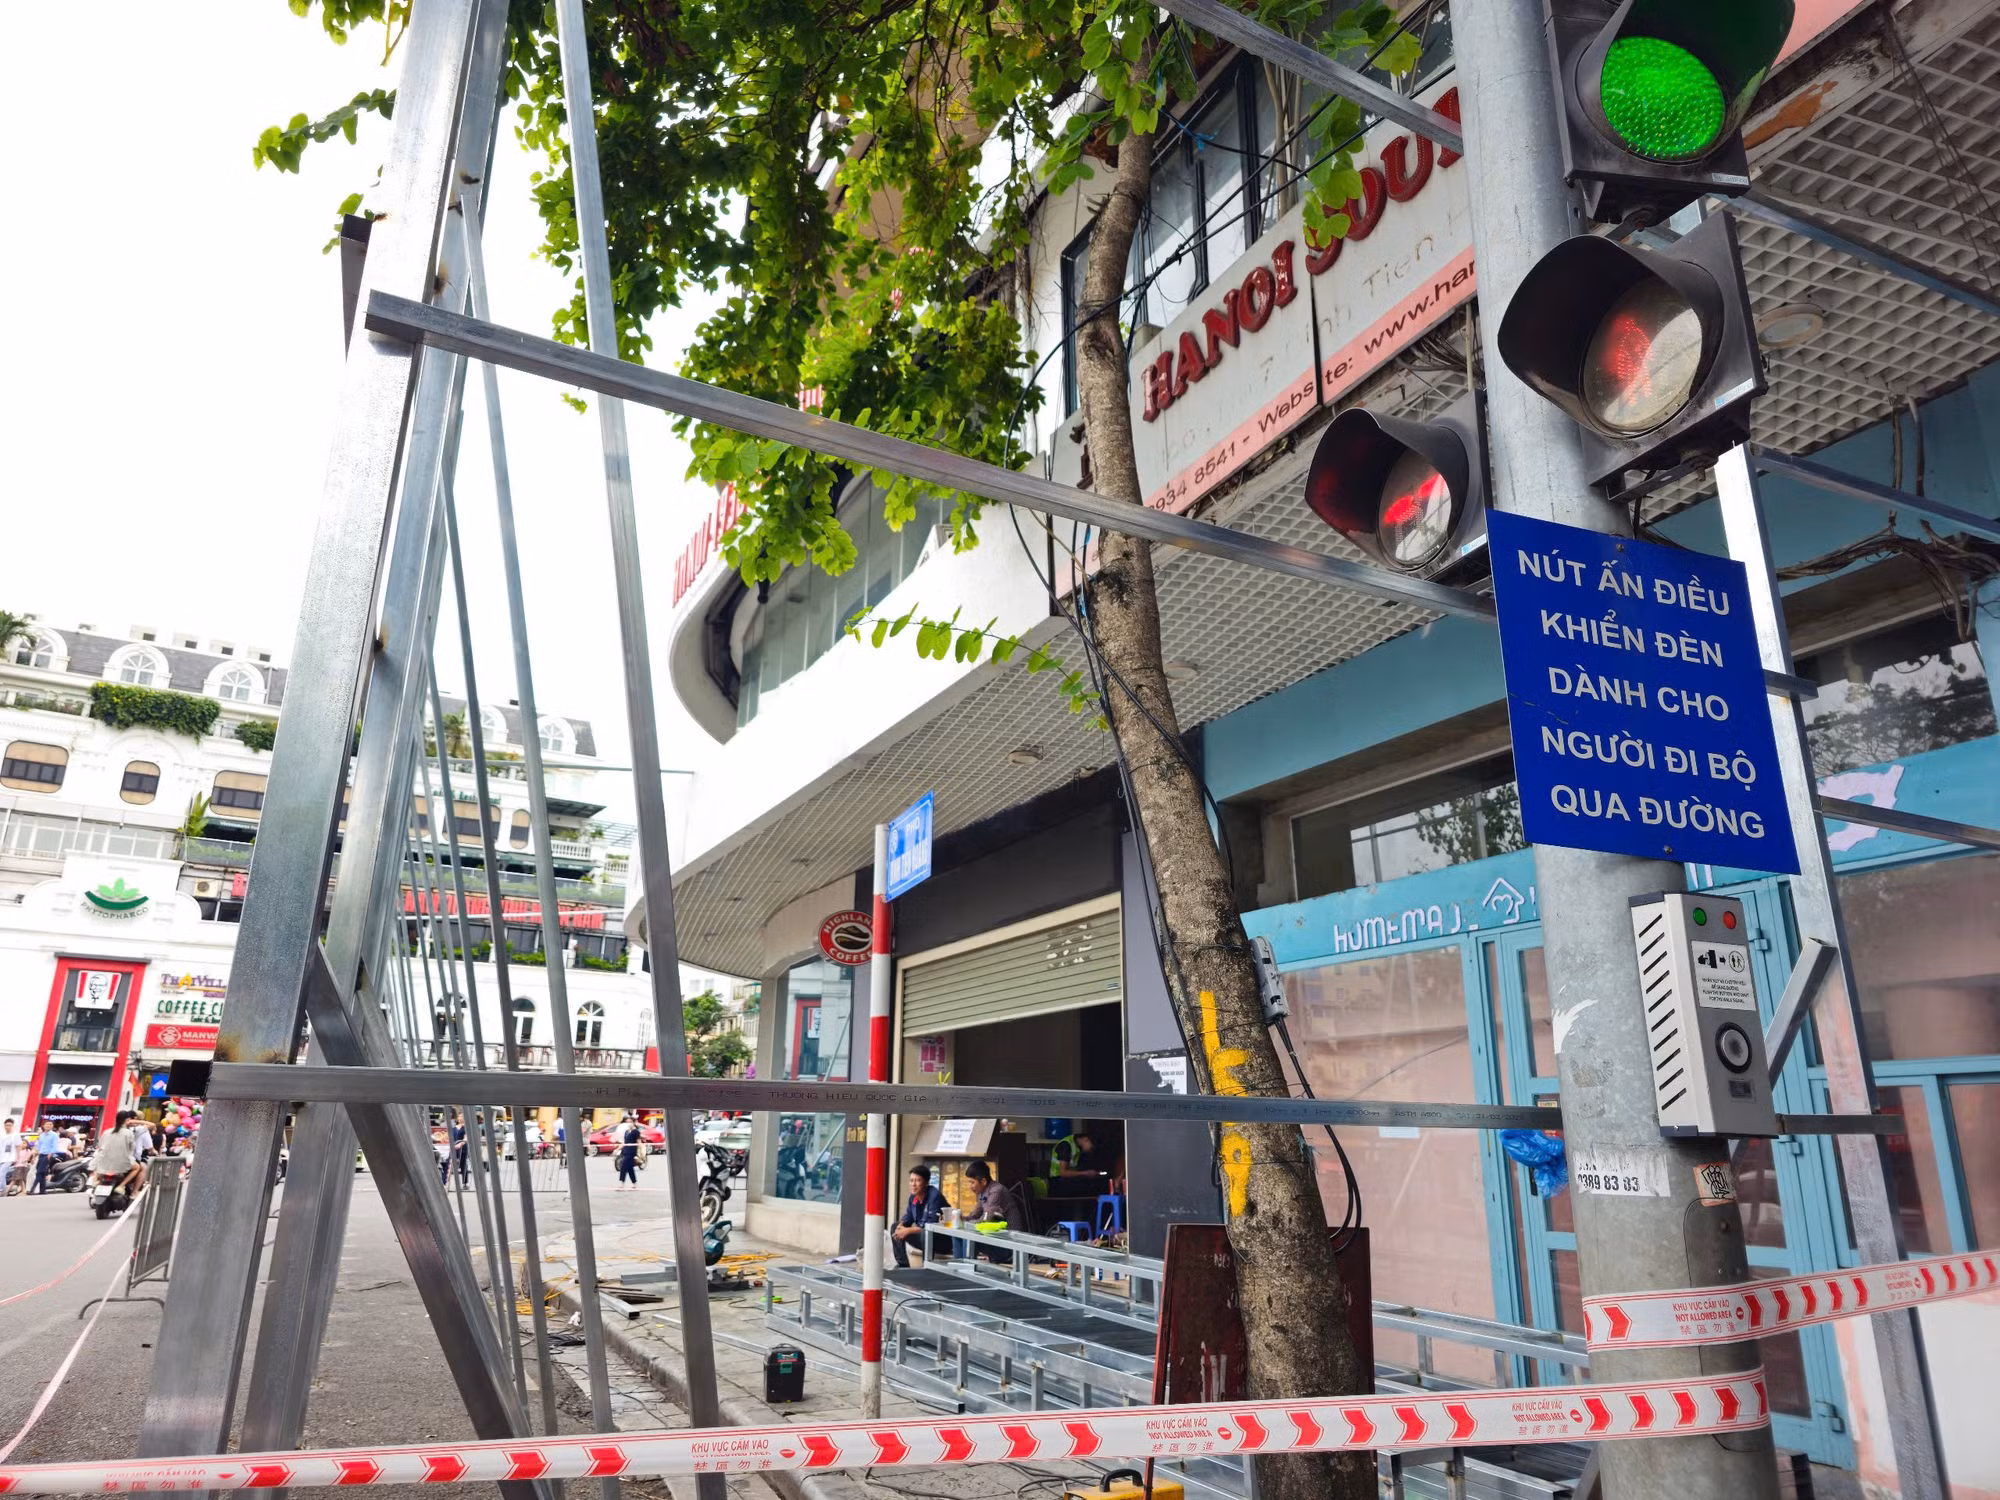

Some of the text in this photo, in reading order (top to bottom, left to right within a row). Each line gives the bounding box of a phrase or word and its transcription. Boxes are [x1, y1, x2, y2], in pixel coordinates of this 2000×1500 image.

[1141, 240, 1298, 423] HANOI
[1194, 441, 1235, 485] 8541
[1517, 549, 1731, 617] NÚT ẤN ĐIỀU
[1540, 608, 1725, 669] KHIỂN ĐÈN
[1548, 663, 1730, 722] DÀNH CHO
[1541, 725, 1758, 792] NGƯỜI ĐI BỘ
[1551, 784, 1766, 840] QUA ĐƯỜNG
[157, 1000, 206, 1015] COFFEE
[46, 1083, 103, 1100] KFC
[1604, 1174, 1619, 1191] 83
[1672, 1303, 1687, 1312] KHU
[1675, 1310, 1732, 1322] NOT ALLOWED AREA
[1511, 1401, 1525, 1411] KHU
[1146, 1420, 1160, 1430] KHU
[1514, 1412, 1567, 1422] NOT ALLOWED AREA
[1148, 1429, 1213, 1440] NOT ALLOWED AREA
[691, 1442, 709, 1453] KHU
